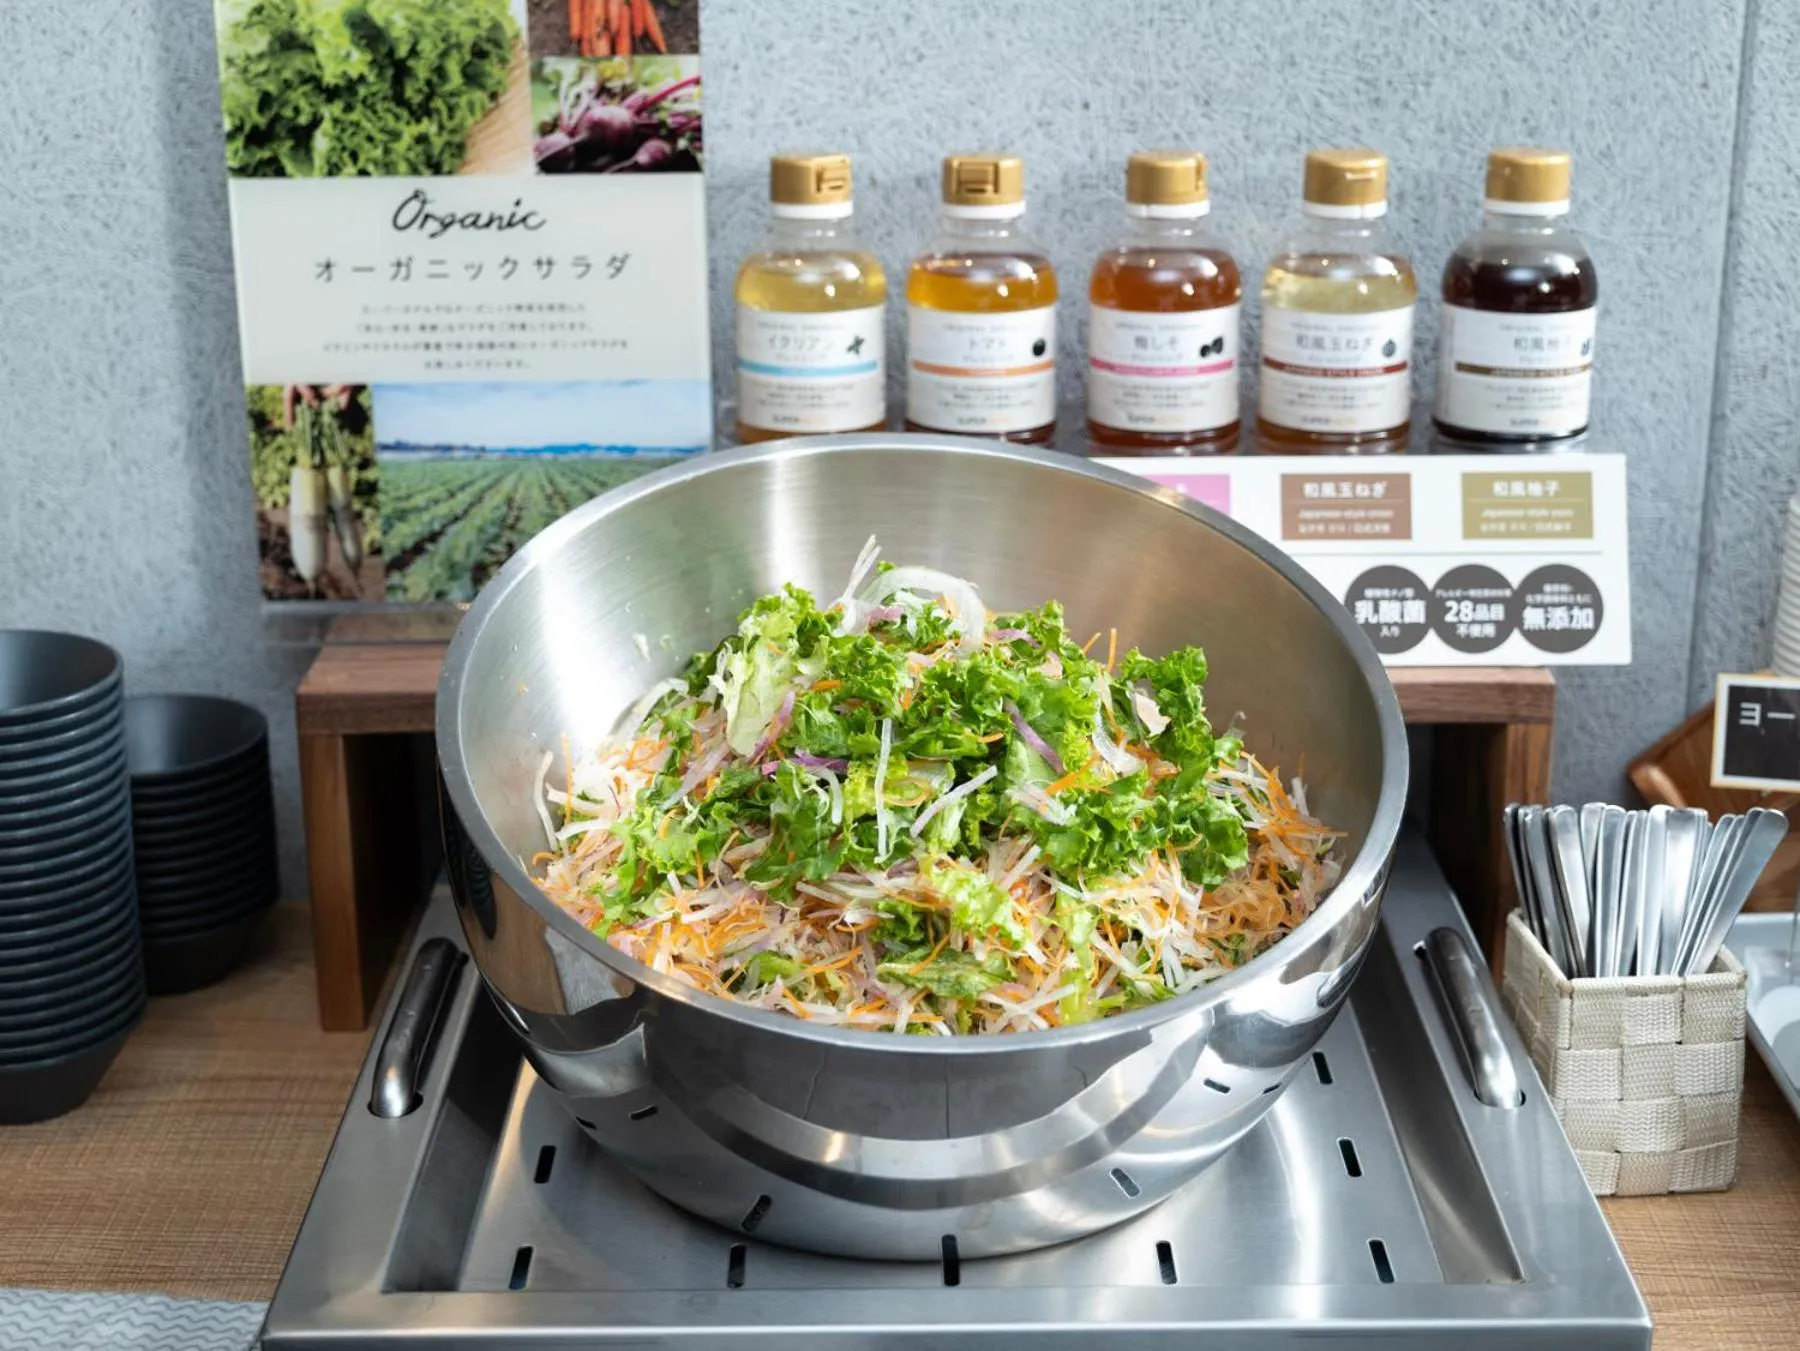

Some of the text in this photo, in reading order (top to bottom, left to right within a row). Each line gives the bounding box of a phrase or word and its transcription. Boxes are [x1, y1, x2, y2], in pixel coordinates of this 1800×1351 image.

[392, 189, 546, 238] Organic
[314, 251, 633, 283] オーガニックサラダ
[1296, 334, 1373, 351] 和風玉ねぎ
[1303, 481, 1388, 498] 和風玉ねぎ
[1492, 479, 1561, 497] 和風柚子
[1354, 600, 1427, 625] 乳酸菌
[1443, 599, 1505, 623] 28品目
[1522, 606, 1595, 629] 無添加
[1455, 623, 1496, 638] 不使用
